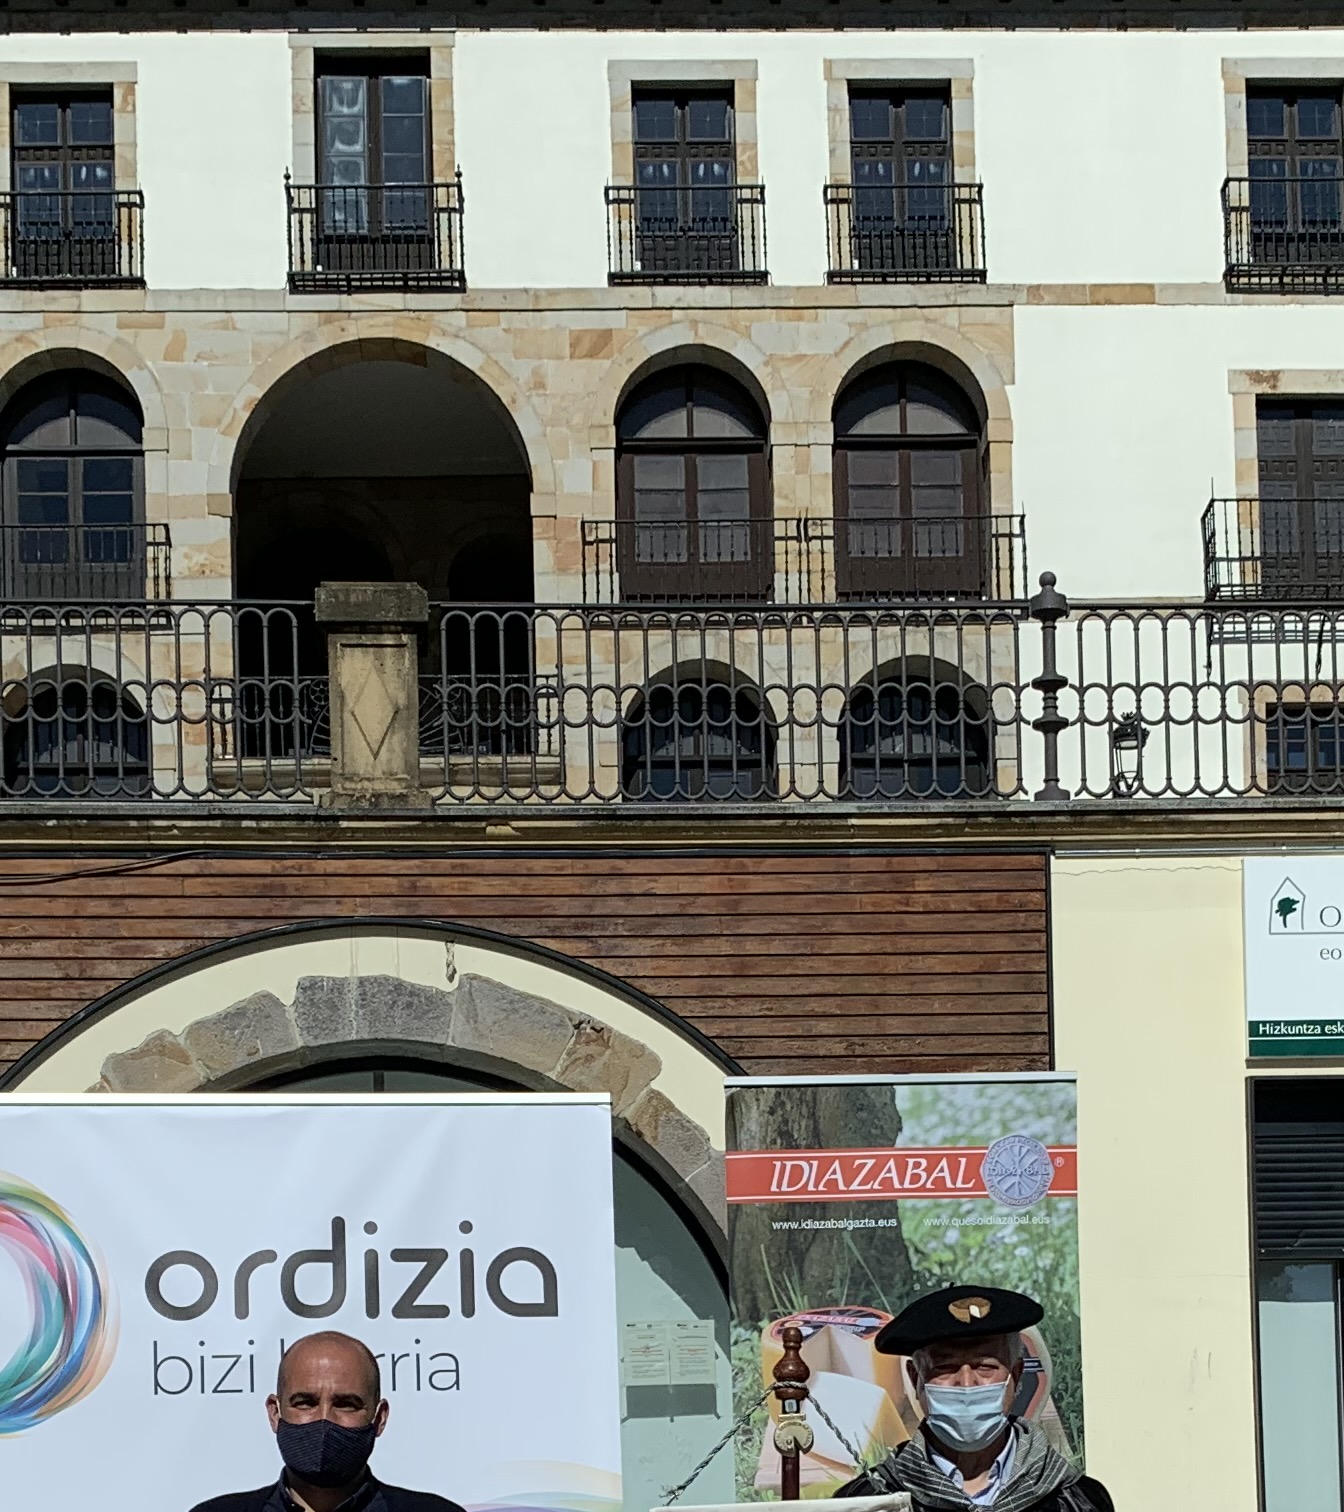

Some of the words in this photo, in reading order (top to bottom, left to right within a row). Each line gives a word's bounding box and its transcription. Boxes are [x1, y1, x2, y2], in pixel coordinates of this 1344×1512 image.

[1259, 1023, 1321, 1035] Hizkuntza
[770, 1157, 976, 1193] IDIAZABAL
[771, 1217, 898, 1231] www.idiazabalgazta.eus
[922, 1214, 1051, 1228] www.quesoidiazabal.eus
[144, 1216, 559, 1321] ordizia
[153, 1339, 255, 1396] bizi
[279, 1337, 461, 1392] ria
